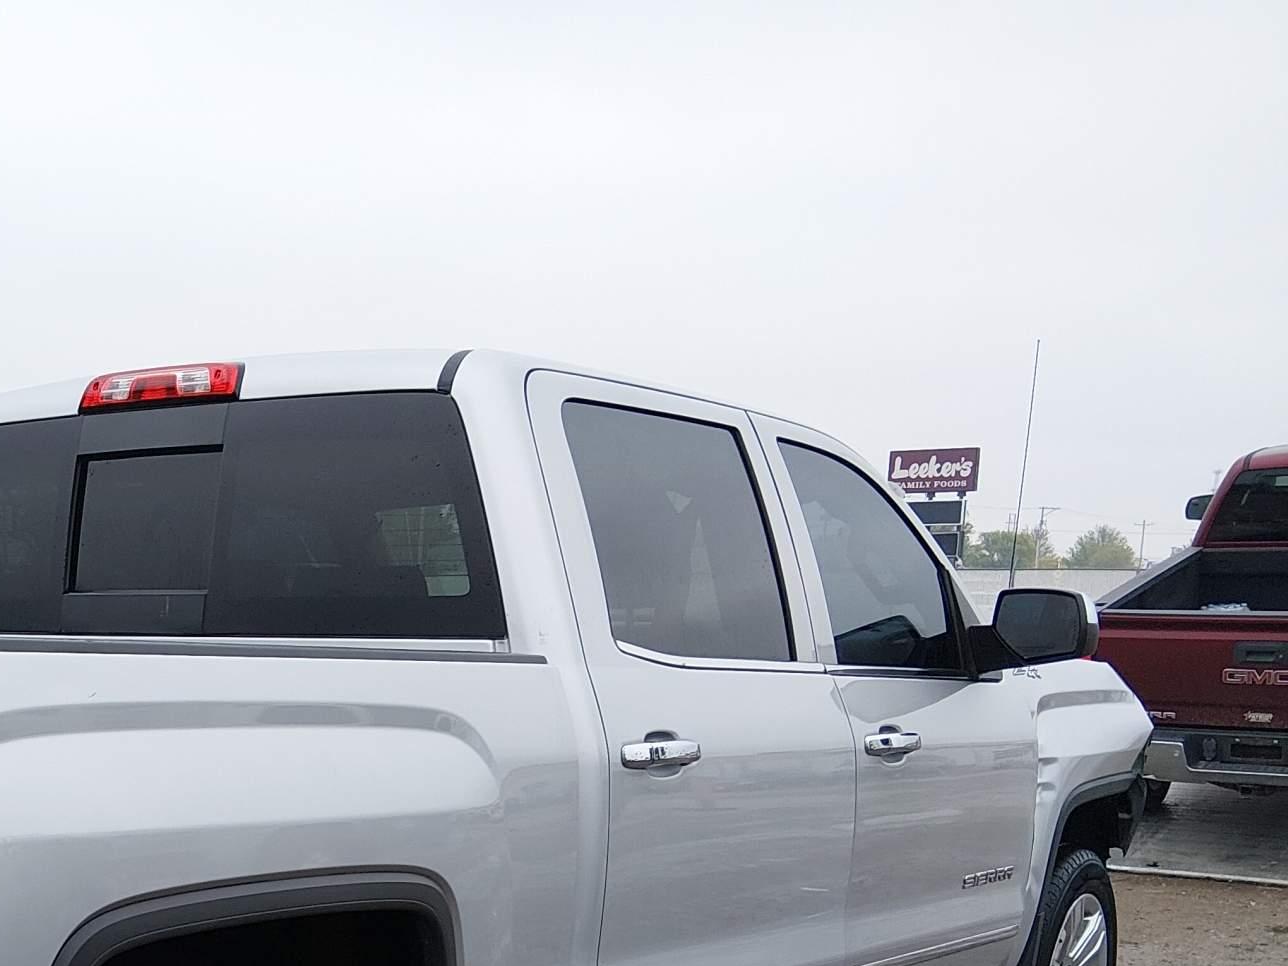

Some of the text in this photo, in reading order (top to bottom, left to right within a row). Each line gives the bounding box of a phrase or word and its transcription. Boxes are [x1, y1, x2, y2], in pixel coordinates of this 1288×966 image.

[891, 454, 974, 480] Leeker's
[933, 480, 967, 488] FOODS
[1222, 668, 1288, 685] GMC
[962, 865, 1015, 890] SIERRA
